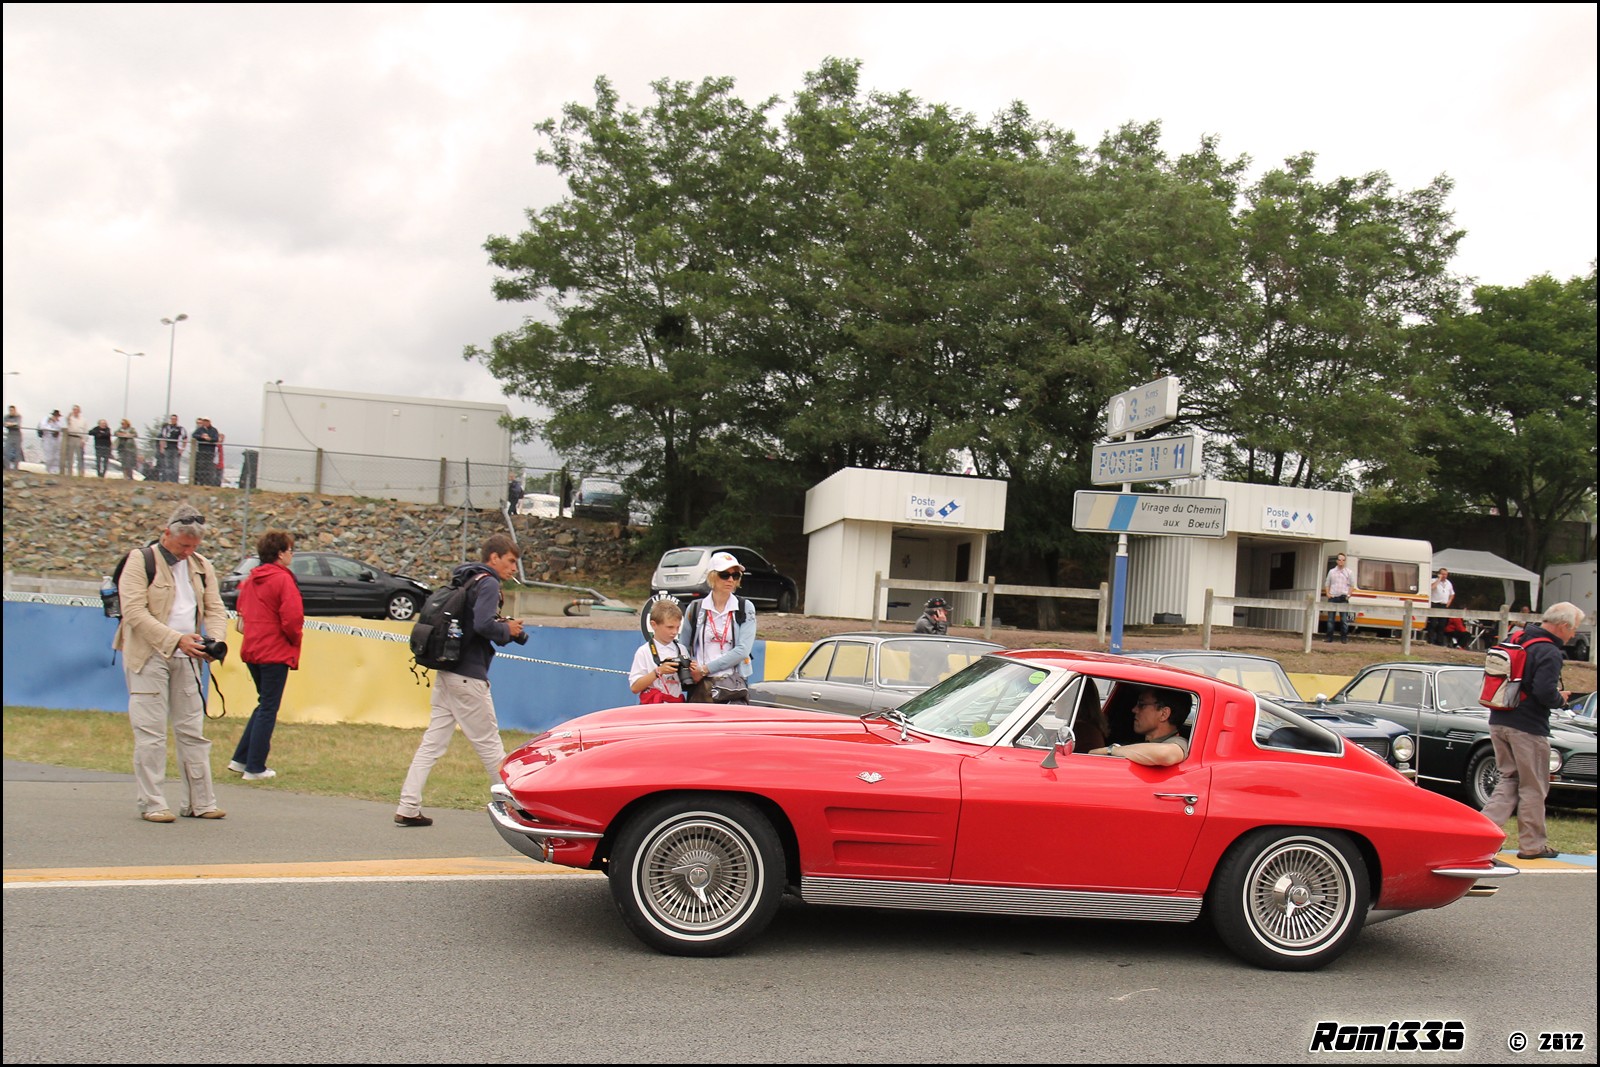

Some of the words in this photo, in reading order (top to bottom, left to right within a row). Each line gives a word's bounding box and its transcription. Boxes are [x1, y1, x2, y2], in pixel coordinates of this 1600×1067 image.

[1145, 390, 1159, 400] Kms
[1099, 449, 1144, 476] POSTE
[1173, 443, 1185, 470] 11
[911, 496, 935, 506] Poste
[914, 508, 922, 517] 11
[1141, 502, 1170, 514] Virage
[1173, 504, 1184, 513] du
[1187, 504, 1221, 515] Chemin
[1267, 507, 1289, 517] Poste
[1163, 519, 1180, 527] aux
[1269, 519, 1277, 528] 11
